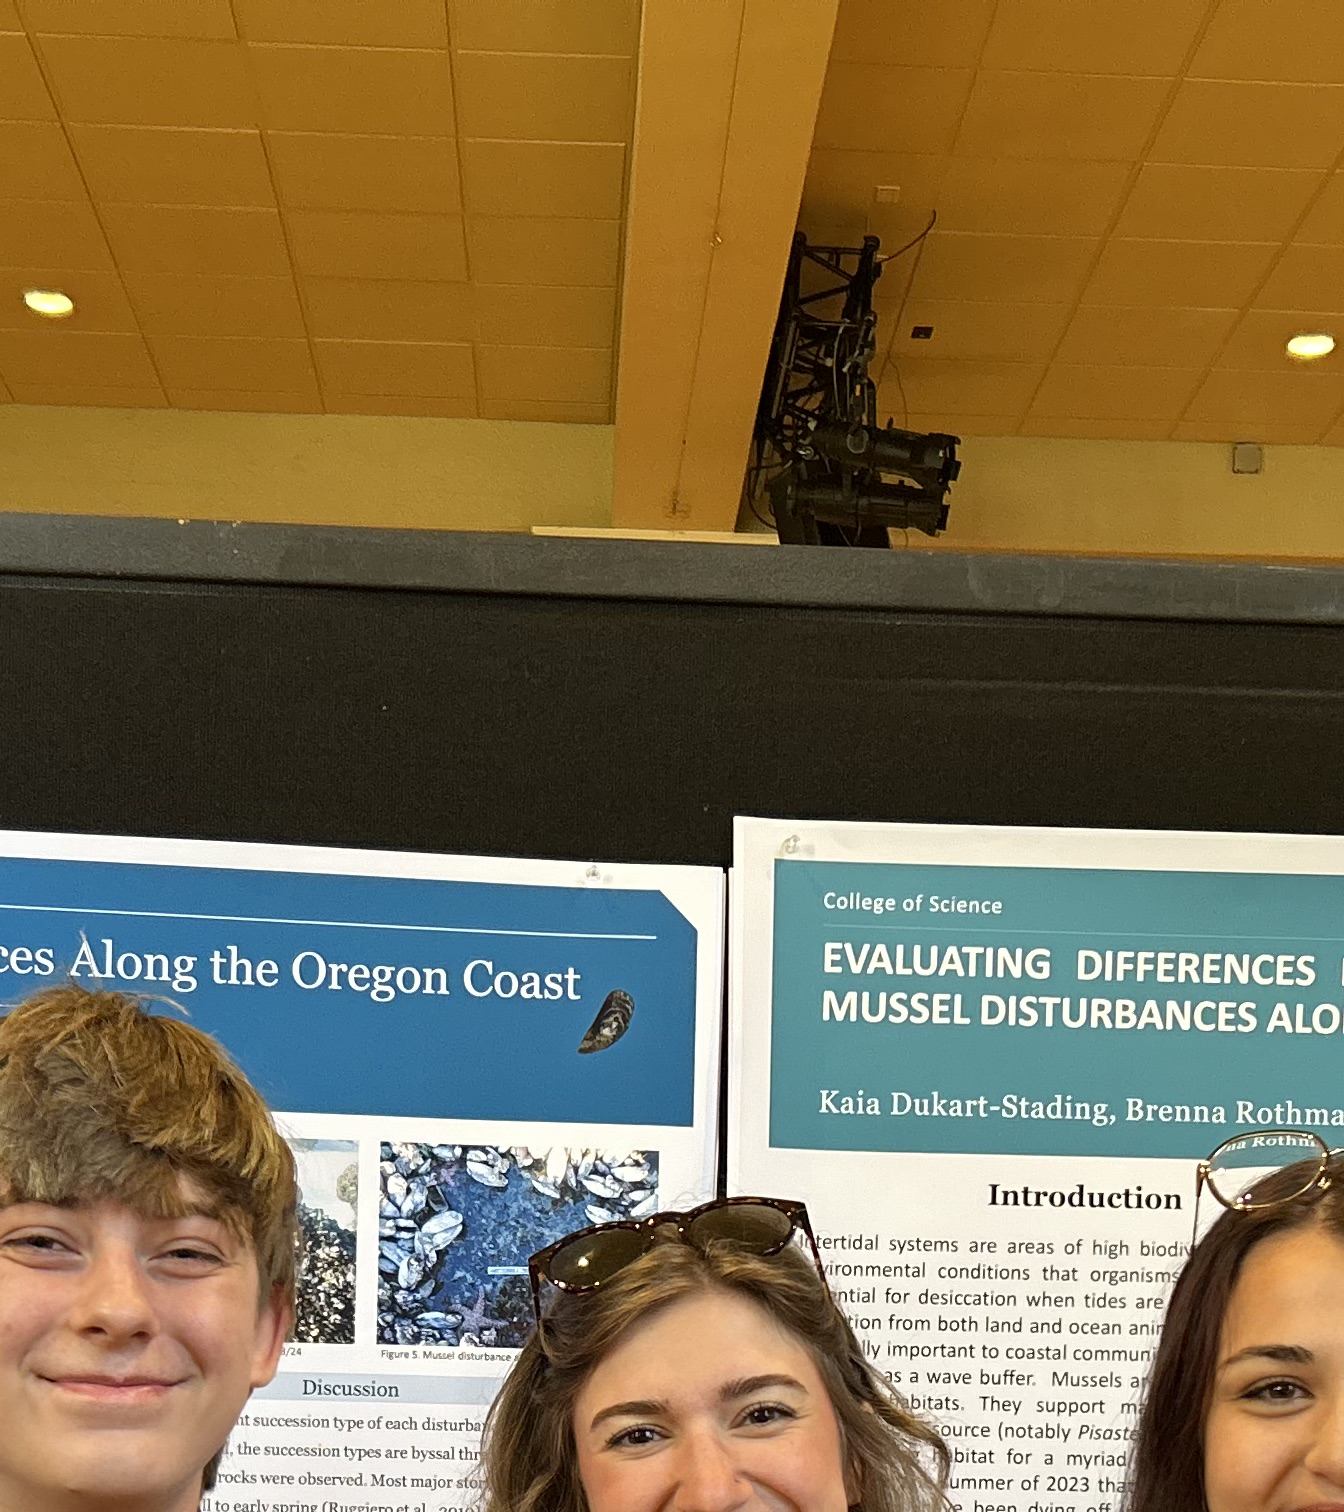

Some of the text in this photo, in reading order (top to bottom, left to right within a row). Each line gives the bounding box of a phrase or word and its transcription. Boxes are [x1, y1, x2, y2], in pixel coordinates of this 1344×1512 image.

[823, 891, 1002, 914] College of Science
[68, 938, 197, 989] Along
[209, 945, 278, 987] the
[292, 951, 450, 1002] Oregon
[463, 959, 581, 1000] Coast
[824, 941, 1051, 979] EVALUATING
[1077, 949, 1316, 986] DIFFERENCES
[822, 990, 971, 1024] MUSSEL
[981, 994, 1257, 1033] DISTURBANCES
[819, 1089, 881, 1115] Kaia
[890, 1091, 1116, 1126] Dukart-Stading,
[1125, 1097, 1227, 1124] Brenna
[988, 1184, 1182, 1210] Introduction
[885, 1287, 1164, 1309] for desiccation when tides are
[381, 1349, 409, 1360] Figure
[422, 1350, 455, 1360] Mussel
[457, 1351, 512, 1362] disturbance
[302, 1378, 399, 1397] Discussion
[239, 1441, 453, 1463] the succession types are byssal
